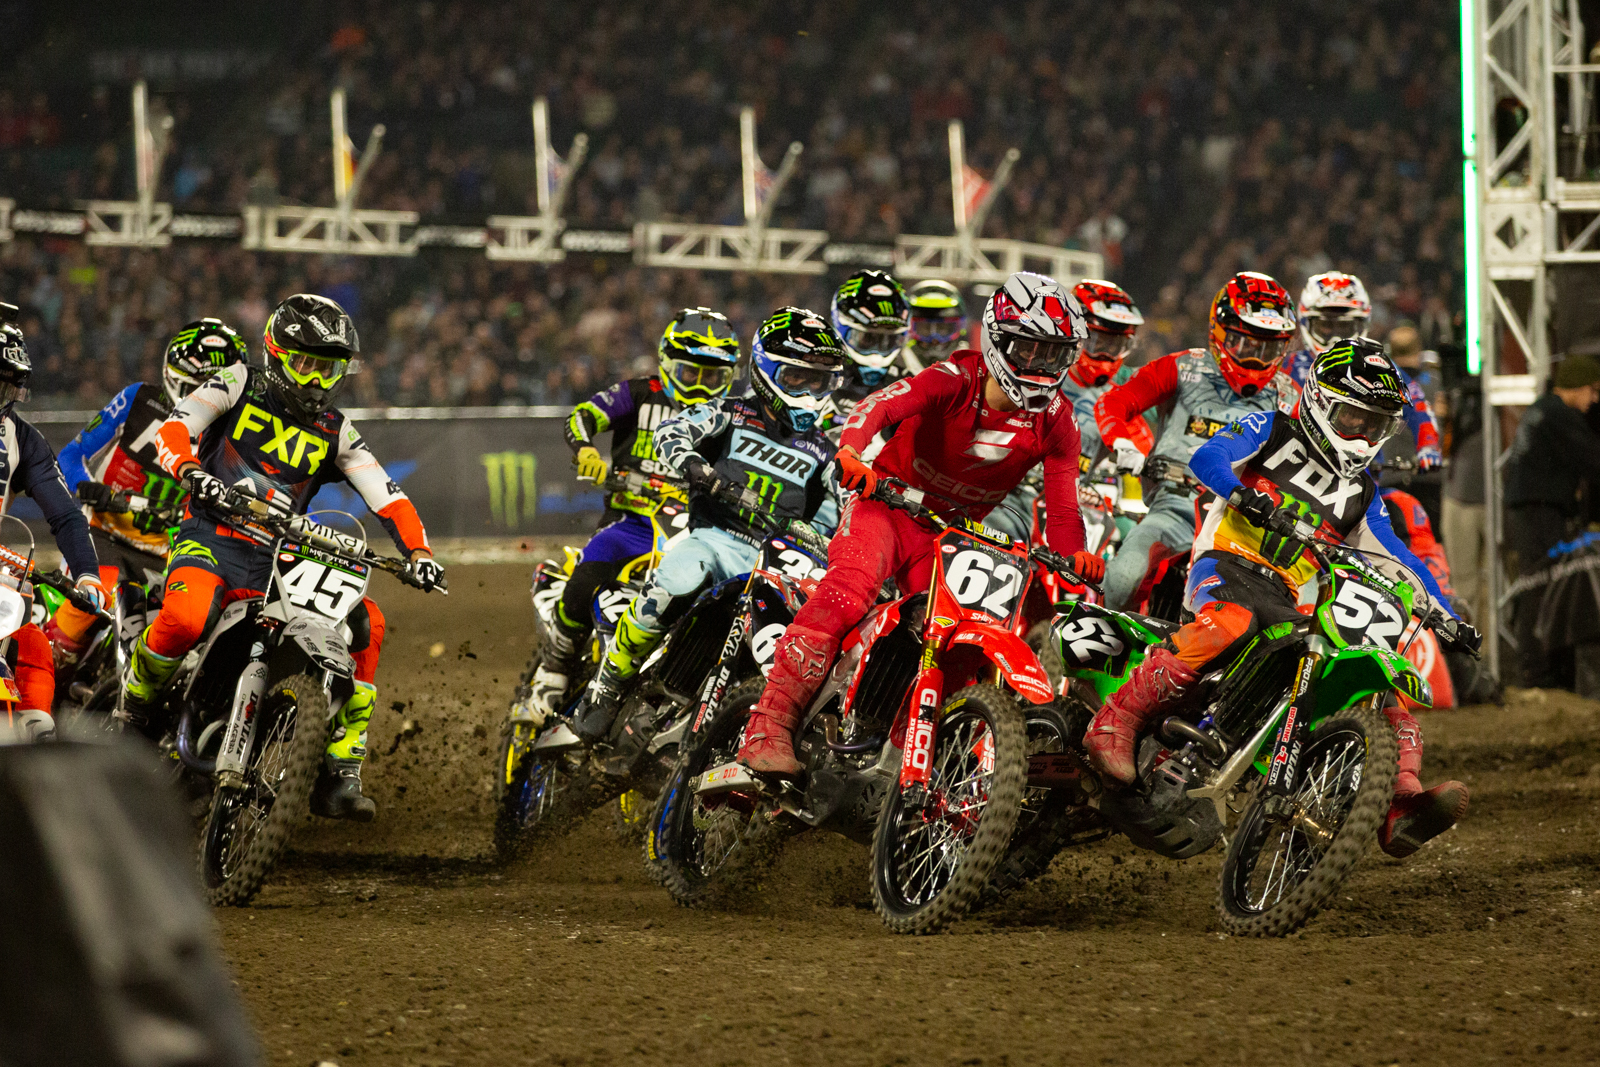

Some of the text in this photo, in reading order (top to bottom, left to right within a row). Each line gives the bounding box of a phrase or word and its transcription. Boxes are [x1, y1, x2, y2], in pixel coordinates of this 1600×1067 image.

[987, 346, 1021, 402] GEICO
[1368, 357, 1386, 365] BELL
[232, 403, 329, 475] FXR
[734, 435, 812, 479] THOR
[912, 457, 1007, 503] GEICO
[1262, 437, 1361, 518] FOX
[980, 543, 1009, 560] MONSTER
[982, 521, 1008, 543] TAPER
[281, 559, 366, 620] 45
[945, 550, 1024, 618] 62
[970, 612, 995, 625] SHIFT
[1331, 579, 1403, 651] 52
[1061, 616, 1125, 664] 52
[702, 665, 730, 725] DUNLO
[1011, 673, 1052, 694] GEICO
[1019, 683, 1048, 699] HONDA
[905, 718, 917, 767] DUNLOP
[912, 688, 938, 771] GICO
[1281, 706, 1297, 744] BRAKING
